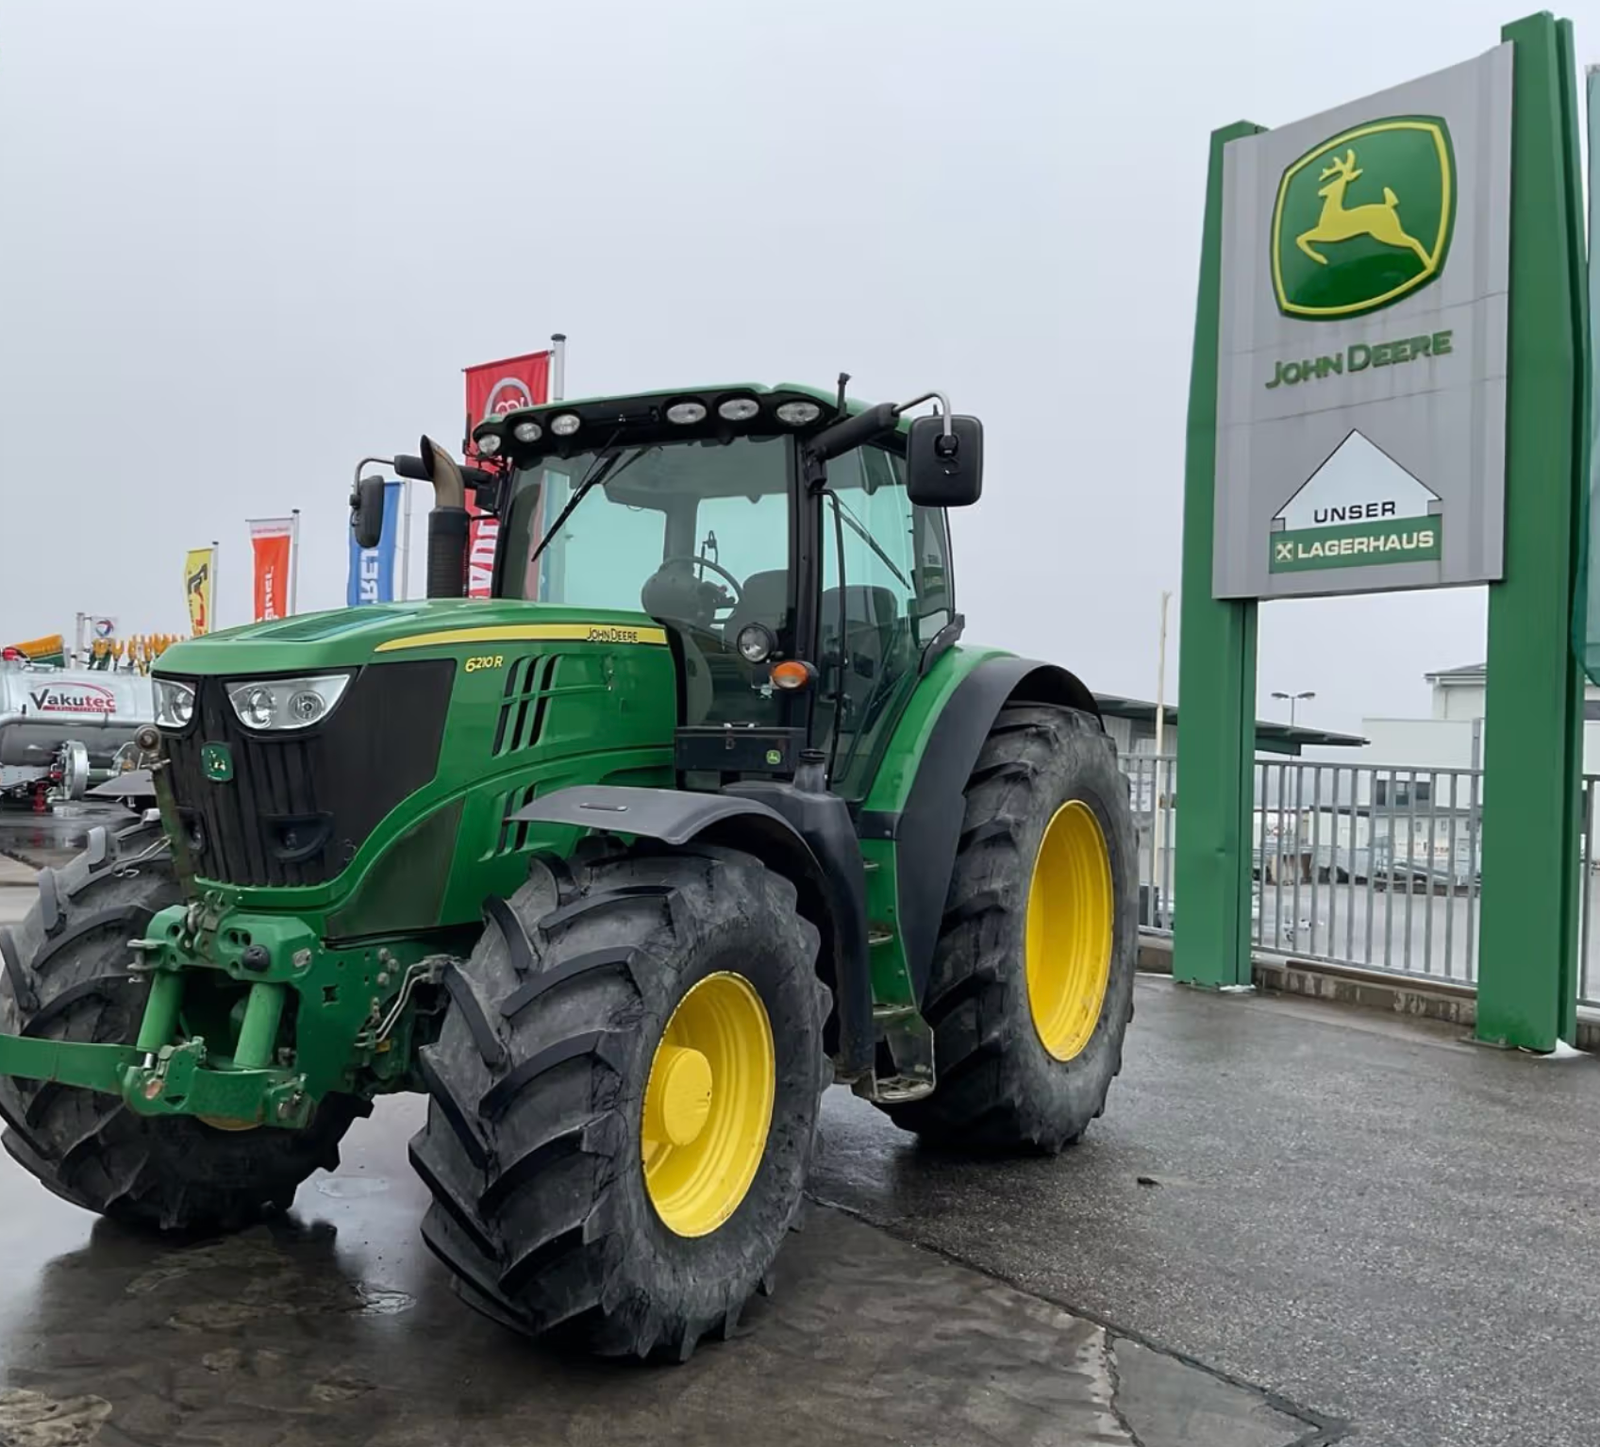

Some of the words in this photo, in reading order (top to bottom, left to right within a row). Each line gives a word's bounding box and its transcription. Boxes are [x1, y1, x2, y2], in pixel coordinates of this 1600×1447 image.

[1265, 352, 1343, 389] JOHN
[1347, 330, 1453, 373] DEERE
[1314, 502, 1396, 523] UNSER
[1297, 530, 1434, 559] LAGERHAUS
[587, 628, 610, 641] JOHN
[611, 628, 638, 642] DEERE
[30, 689, 115, 710] Vakutec
